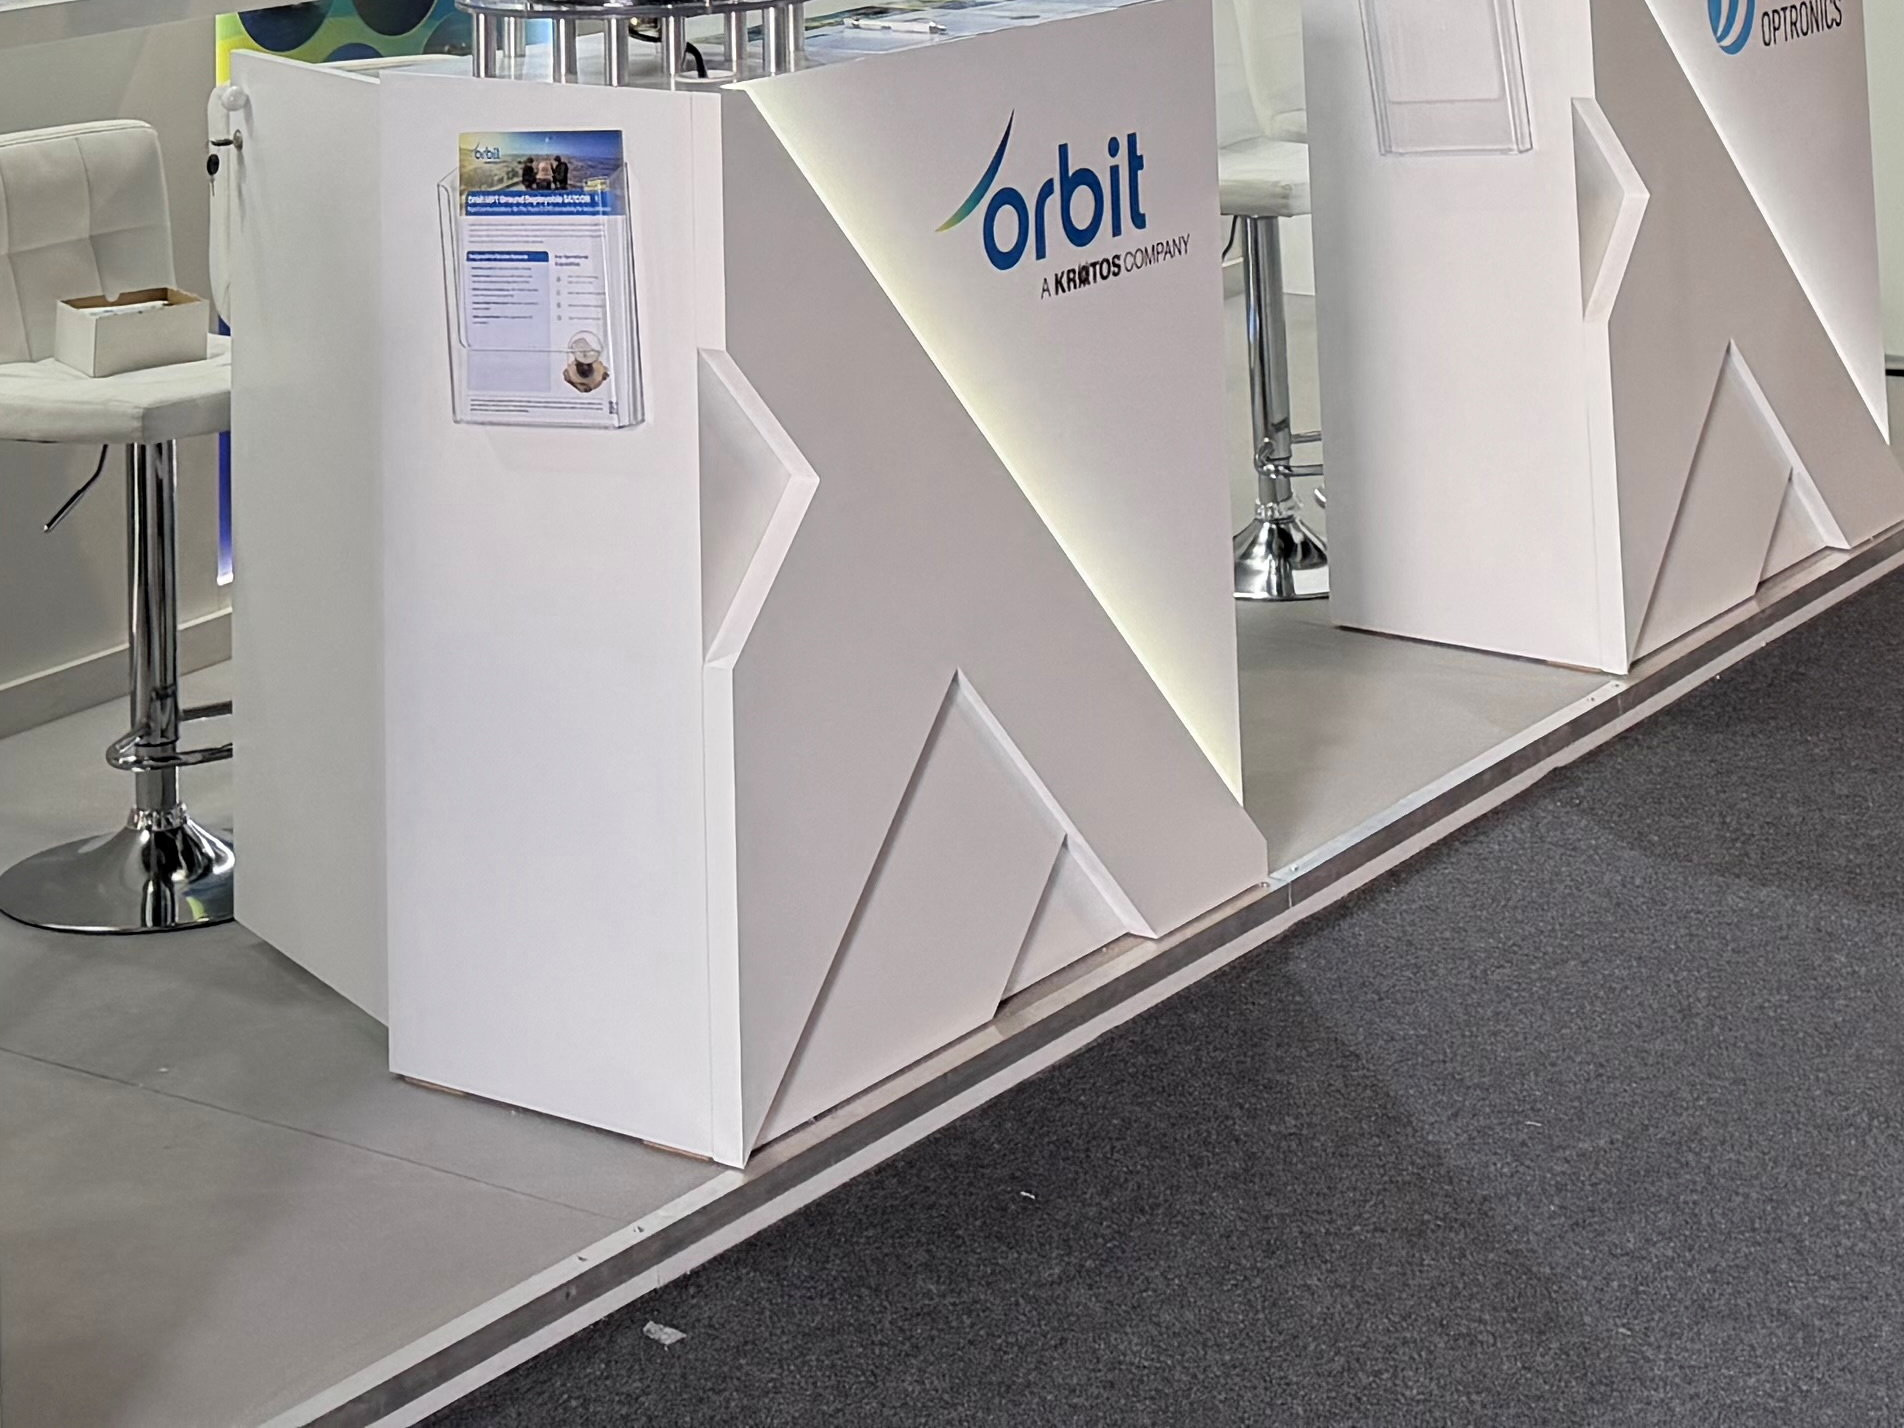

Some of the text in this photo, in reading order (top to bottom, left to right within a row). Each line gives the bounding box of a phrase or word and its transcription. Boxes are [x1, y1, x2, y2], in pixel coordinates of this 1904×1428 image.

[983, 132, 1146, 271] orbit
[1040, 233, 1191, 300] A KRATOS COMPANY
